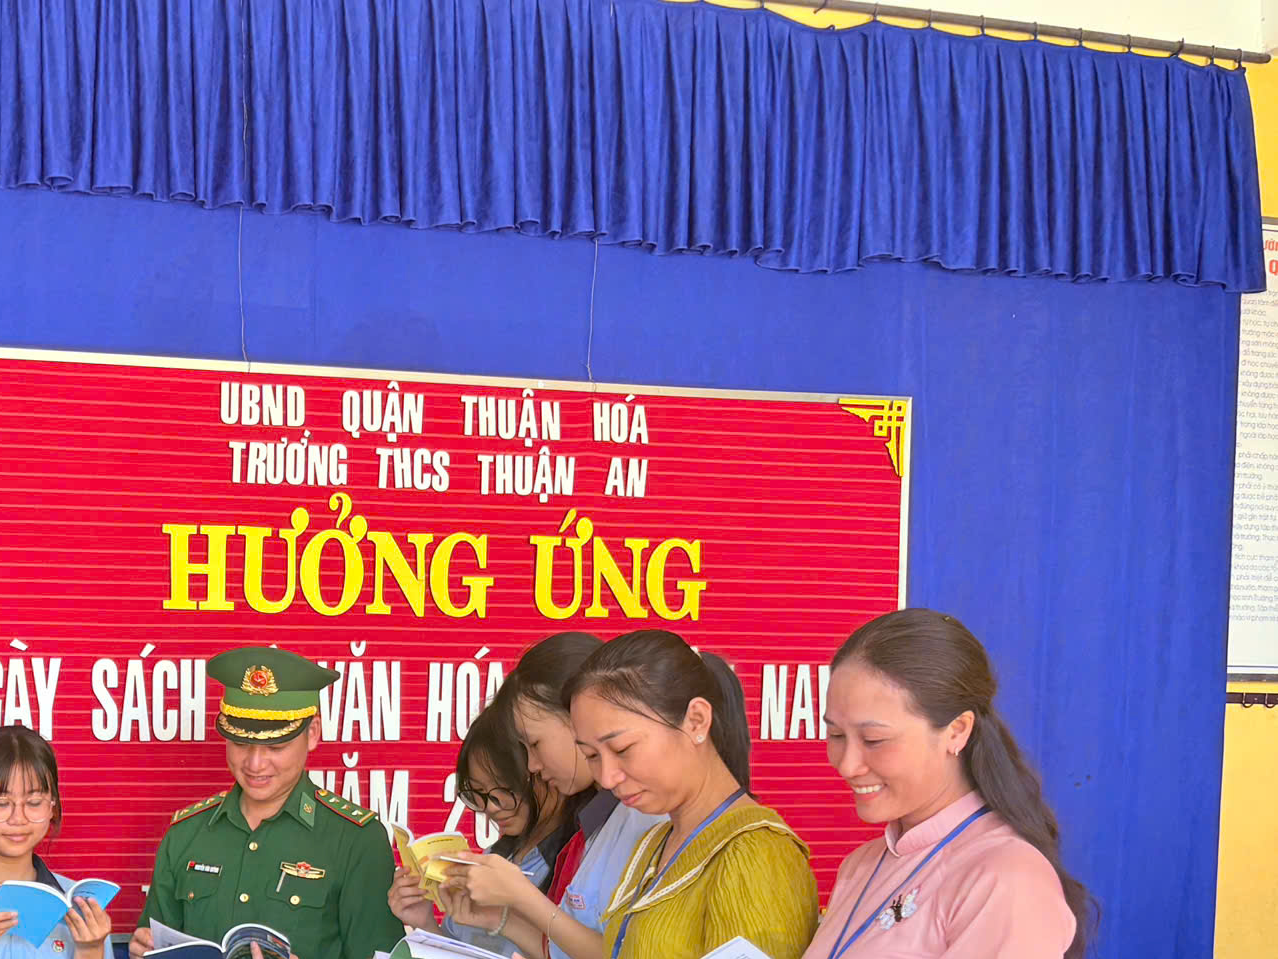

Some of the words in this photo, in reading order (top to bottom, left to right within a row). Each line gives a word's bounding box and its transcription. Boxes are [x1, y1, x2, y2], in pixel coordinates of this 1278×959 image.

[220, 382, 305, 427] UBND
[342, 381, 424, 442] QUẬN
[461, 388, 560, 447] THUẬN
[593, 394, 649, 444] HÓA
[375, 447, 450, 492] THCS
[478, 446, 575, 503] THUẬN
[604, 457, 649, 498] AN
[162, 492, 494, 618] HƯỞNG
[530, 508, 707, 621] ỨNG
[91, 643, 206, 742] SÁCH
[317, 640, 401, 742] VĂN
